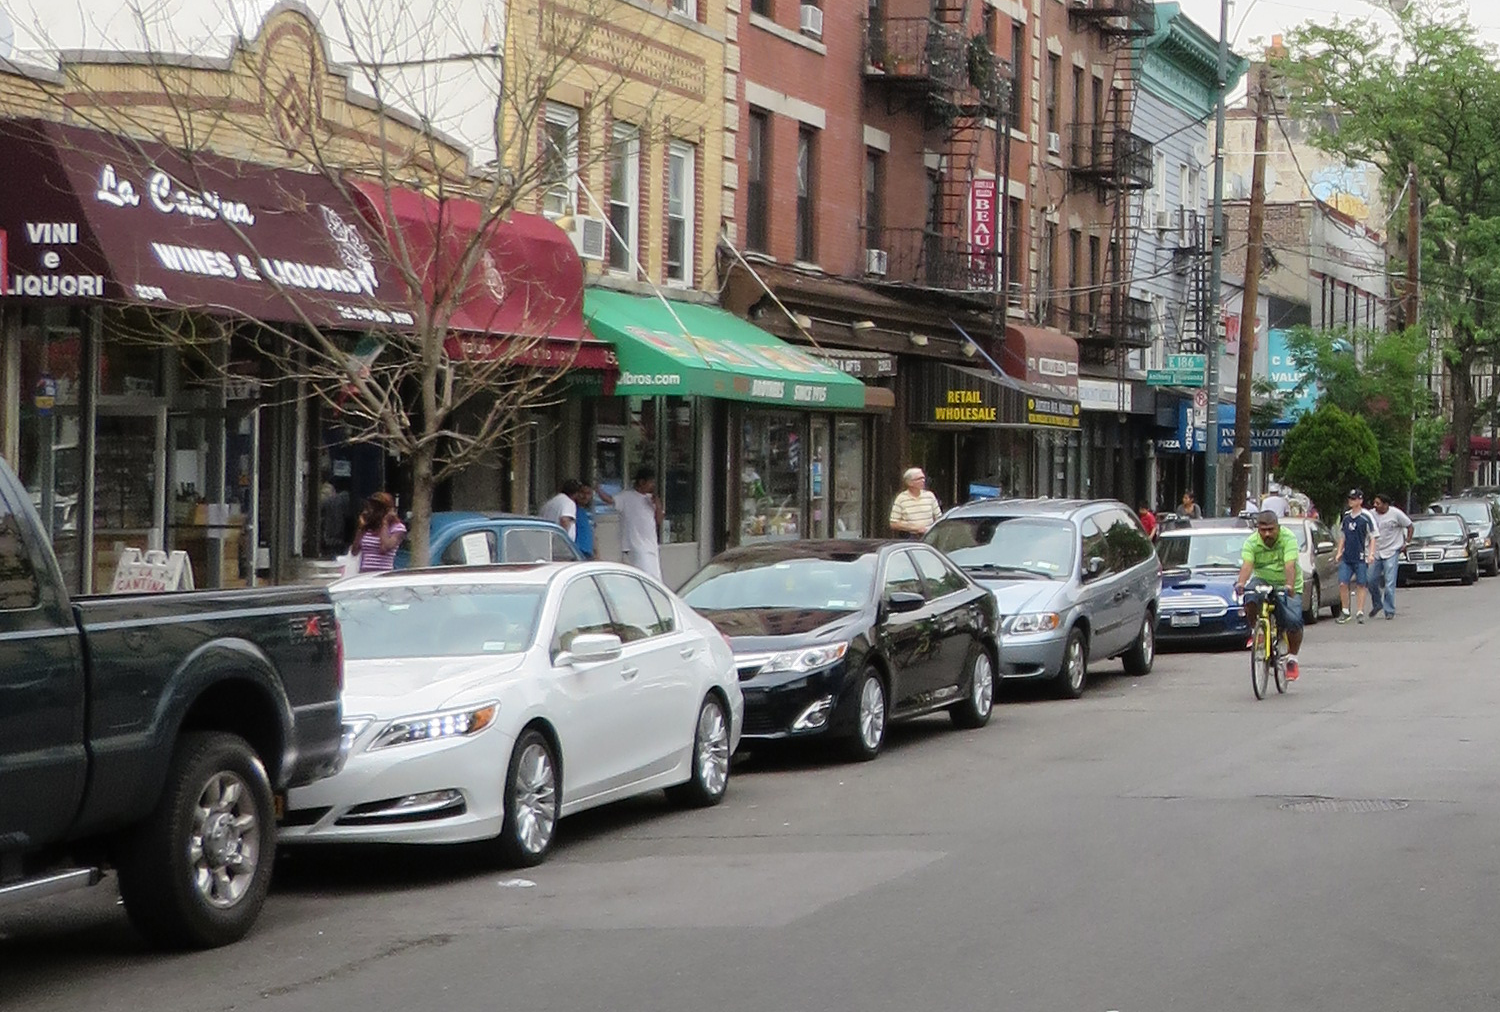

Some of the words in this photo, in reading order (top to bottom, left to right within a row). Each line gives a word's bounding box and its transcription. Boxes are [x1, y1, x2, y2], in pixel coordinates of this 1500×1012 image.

[97, 163, 140, 207] La
[149, 171, 255, 226] Cantina
[26, 222, 78, 244] VINI
[974, 198, 991, 271] BEAUY
[43, 251, 61, 269] e
[151, 242, 237, 279] WINES
[236, 253, 263, 283] &
[260, 258, 362, 294] LIQUORS
[1178, 357, 1194, 368] 186
[947, 390, 982, 404] RETAIL
[935, 407, 997, 421] WHOLESALE
[1158, 440, 1181, 449] PIZZA
